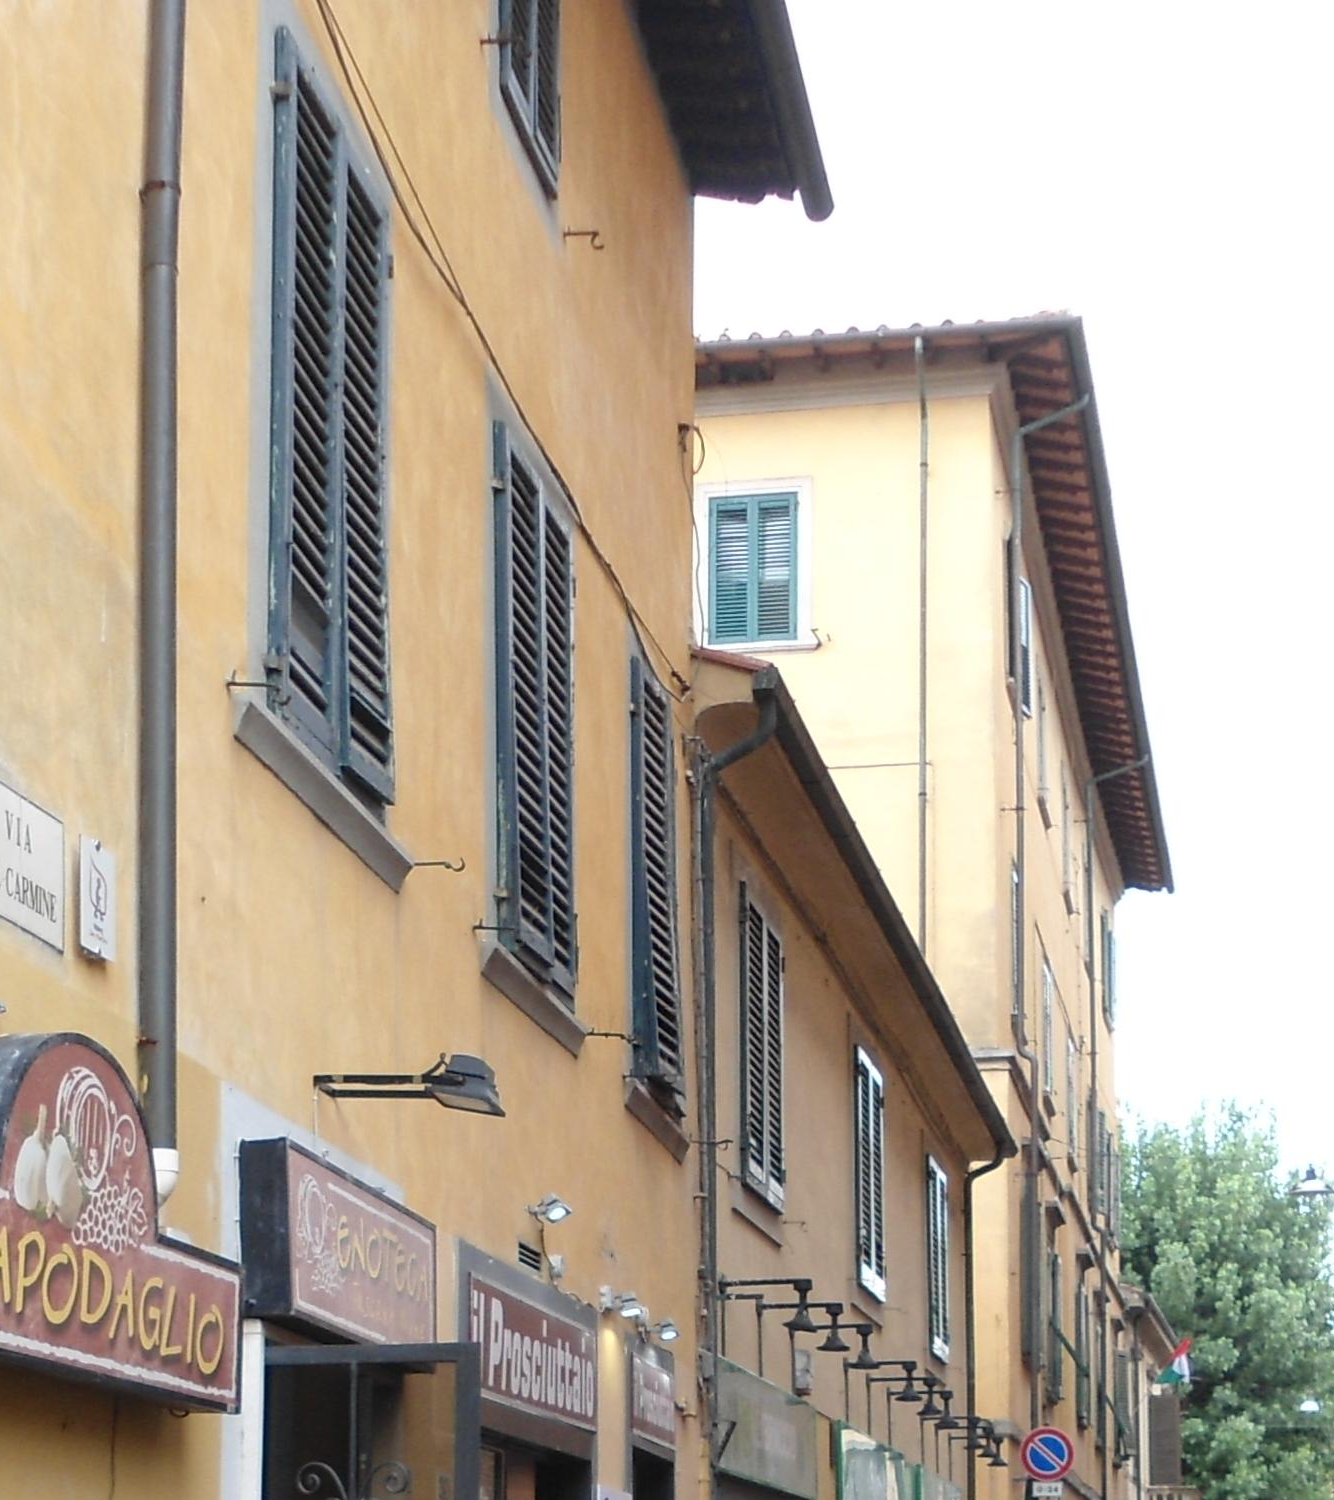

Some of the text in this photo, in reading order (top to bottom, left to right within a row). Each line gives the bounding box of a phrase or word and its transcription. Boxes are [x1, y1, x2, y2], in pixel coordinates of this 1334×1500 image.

[4, 810, 33, 854] VIA
[5, 867, 57, 924] CARMINE
[336, 1215, 429, 1302] ENOTECA
[487, 1296, 595, 1418] Prosciuttaio
